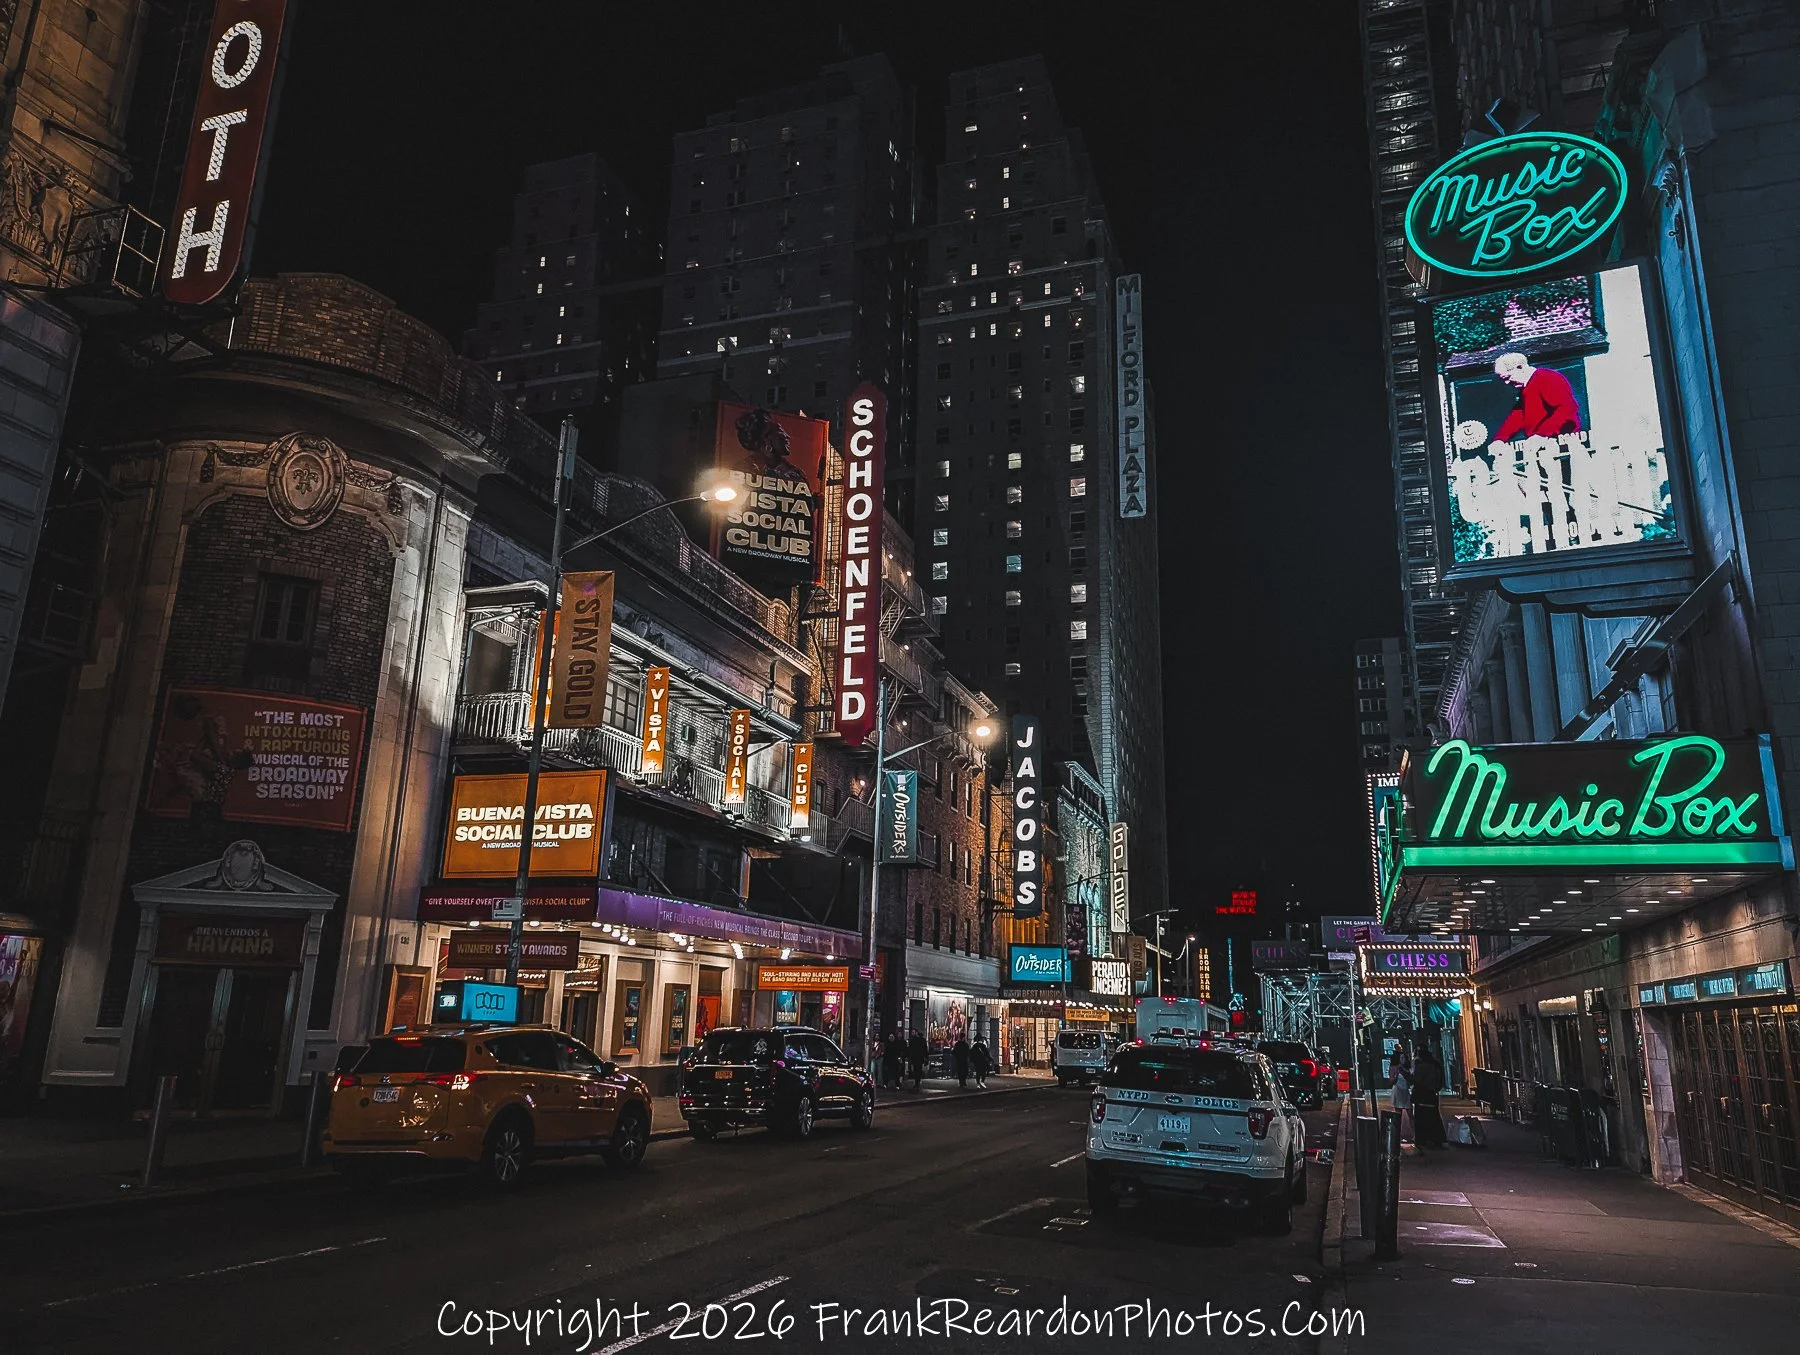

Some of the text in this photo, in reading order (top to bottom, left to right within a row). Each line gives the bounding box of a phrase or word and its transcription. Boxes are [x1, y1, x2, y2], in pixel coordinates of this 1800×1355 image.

[171, 0, 262, 279] OTH
[1429, 144, 1586, 229] Music
[1460, 186, 1606, 265] Box
[1118, 277, 1143, 514] MILFORD PLAZA
[728, 507, 811, 536] SOCIAL
[726, 528, 811, 556] CLUB
[748, 550, 782, 560] BROADWAY
[782, 555, 810, 564] MUSICAL
[841, 398, 874, 722] SCHOENFELD
[563, 597, 601, 721] STAY GOLD
[244, 725, 351, 741] INTOXICATING
[300, 712, 344, 727] MOST
[647, 688, 666, 752] VISTA
[244, 739, 350, 755] & RAPTUROUS
[252, 754, 350, 768] MUSICAL OF THE
[730, 723, 745, 790] SOCIAL
[247, 766, 349, 784] BROADWAY
[795, 763, 809, 805] CLUB
[1428, 739, 1624, 839] Music
[1629, 736, 1759, 836] Box
[457, 803, 594, 821] BUENA VISTA
[1016, 726, 1037, 905] JACOBS
[454, 823, 592, 841] SOCIAL CLUB
[1113, 827, 1125, 928] GOLDEN
[187, 935, 274, 955] HAVANA
[262, 928, 269, 937] A
[457, 945, 493, 954] WINNER!
[495, 945, 501, 954] 5
[529, 945, 568, 956] AWARDS
[1386, 953, 1449, 967] CHESS
[1117, 1089, 1239, 1109] NYPD POLICE
